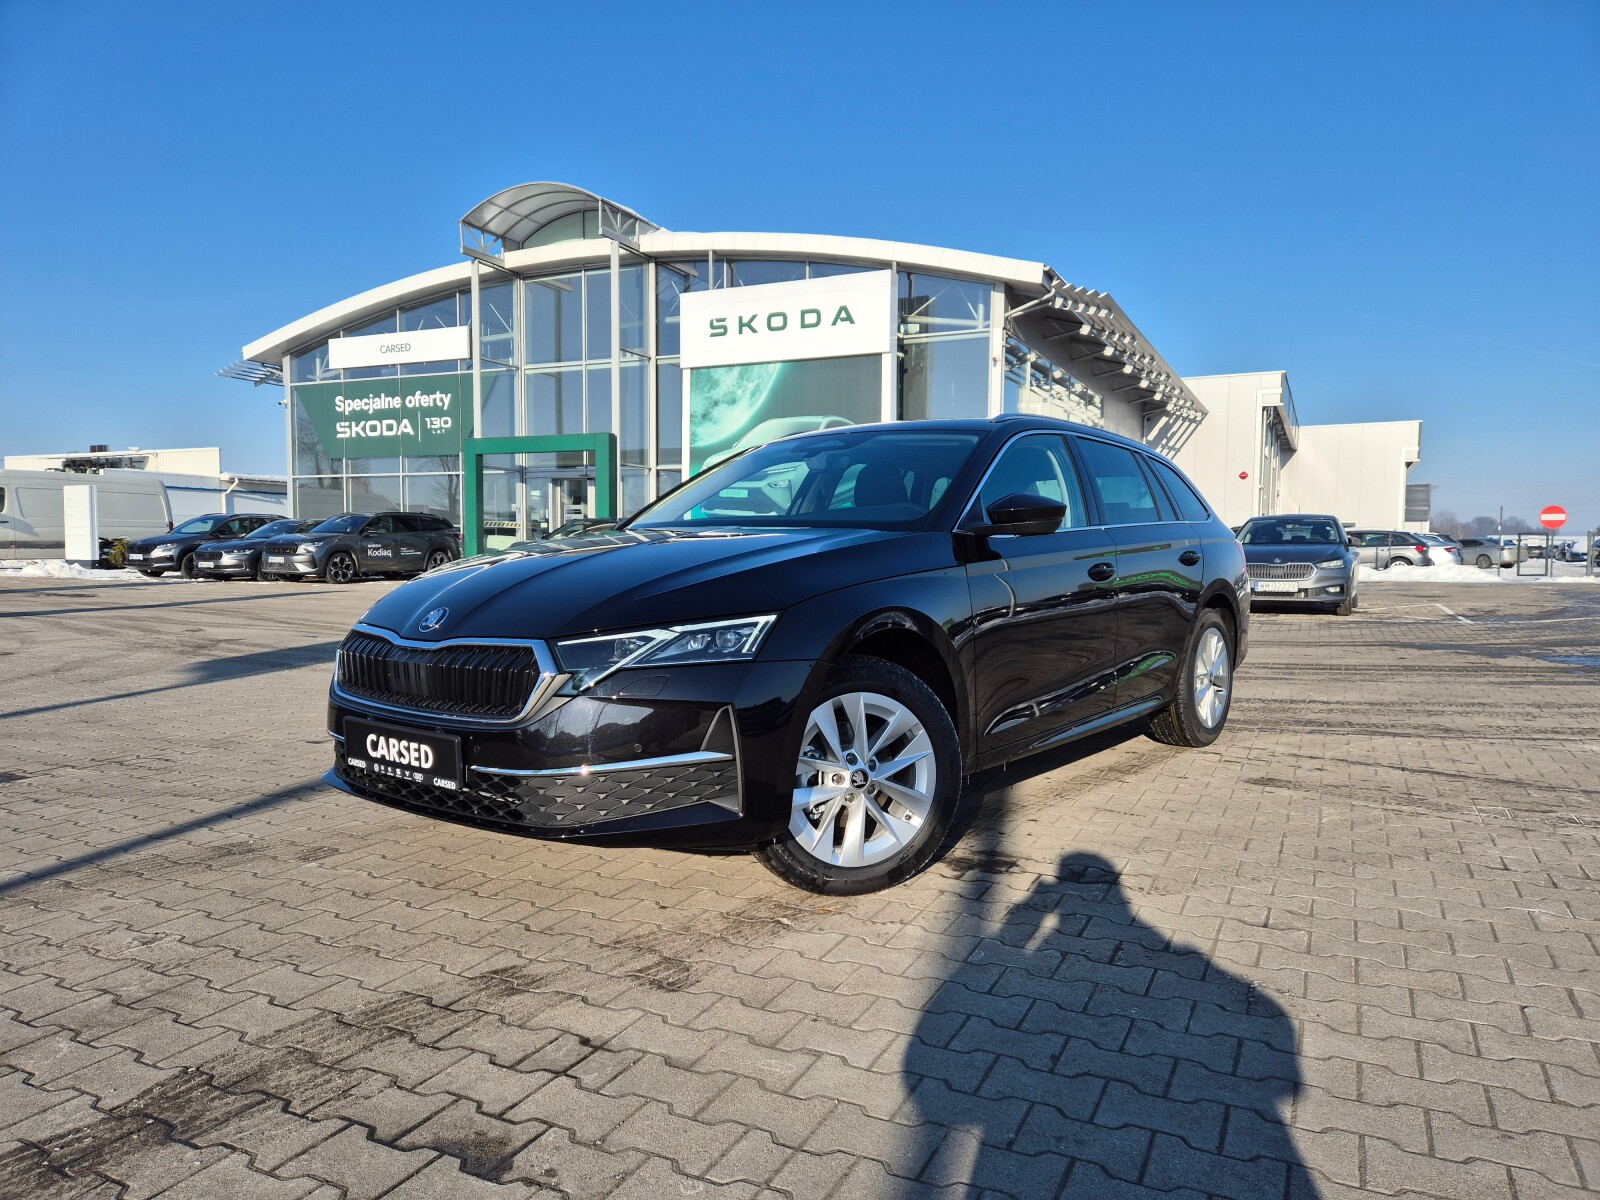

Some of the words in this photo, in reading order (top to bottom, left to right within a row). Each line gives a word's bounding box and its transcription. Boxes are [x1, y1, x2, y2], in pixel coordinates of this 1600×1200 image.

[380, 343, 412, 354] CARSED
[335, 393, 402, 415] Specjalne
[405, 391, 452, 410] oferty
[425, 416, 452, 429] 130
[368, 548, 392, 558] Kodiaq
[366, 734, 432, 768] CARSED
[348, 758, 366, 768] CARSED
[434, 778, 456, 790] CARSED
